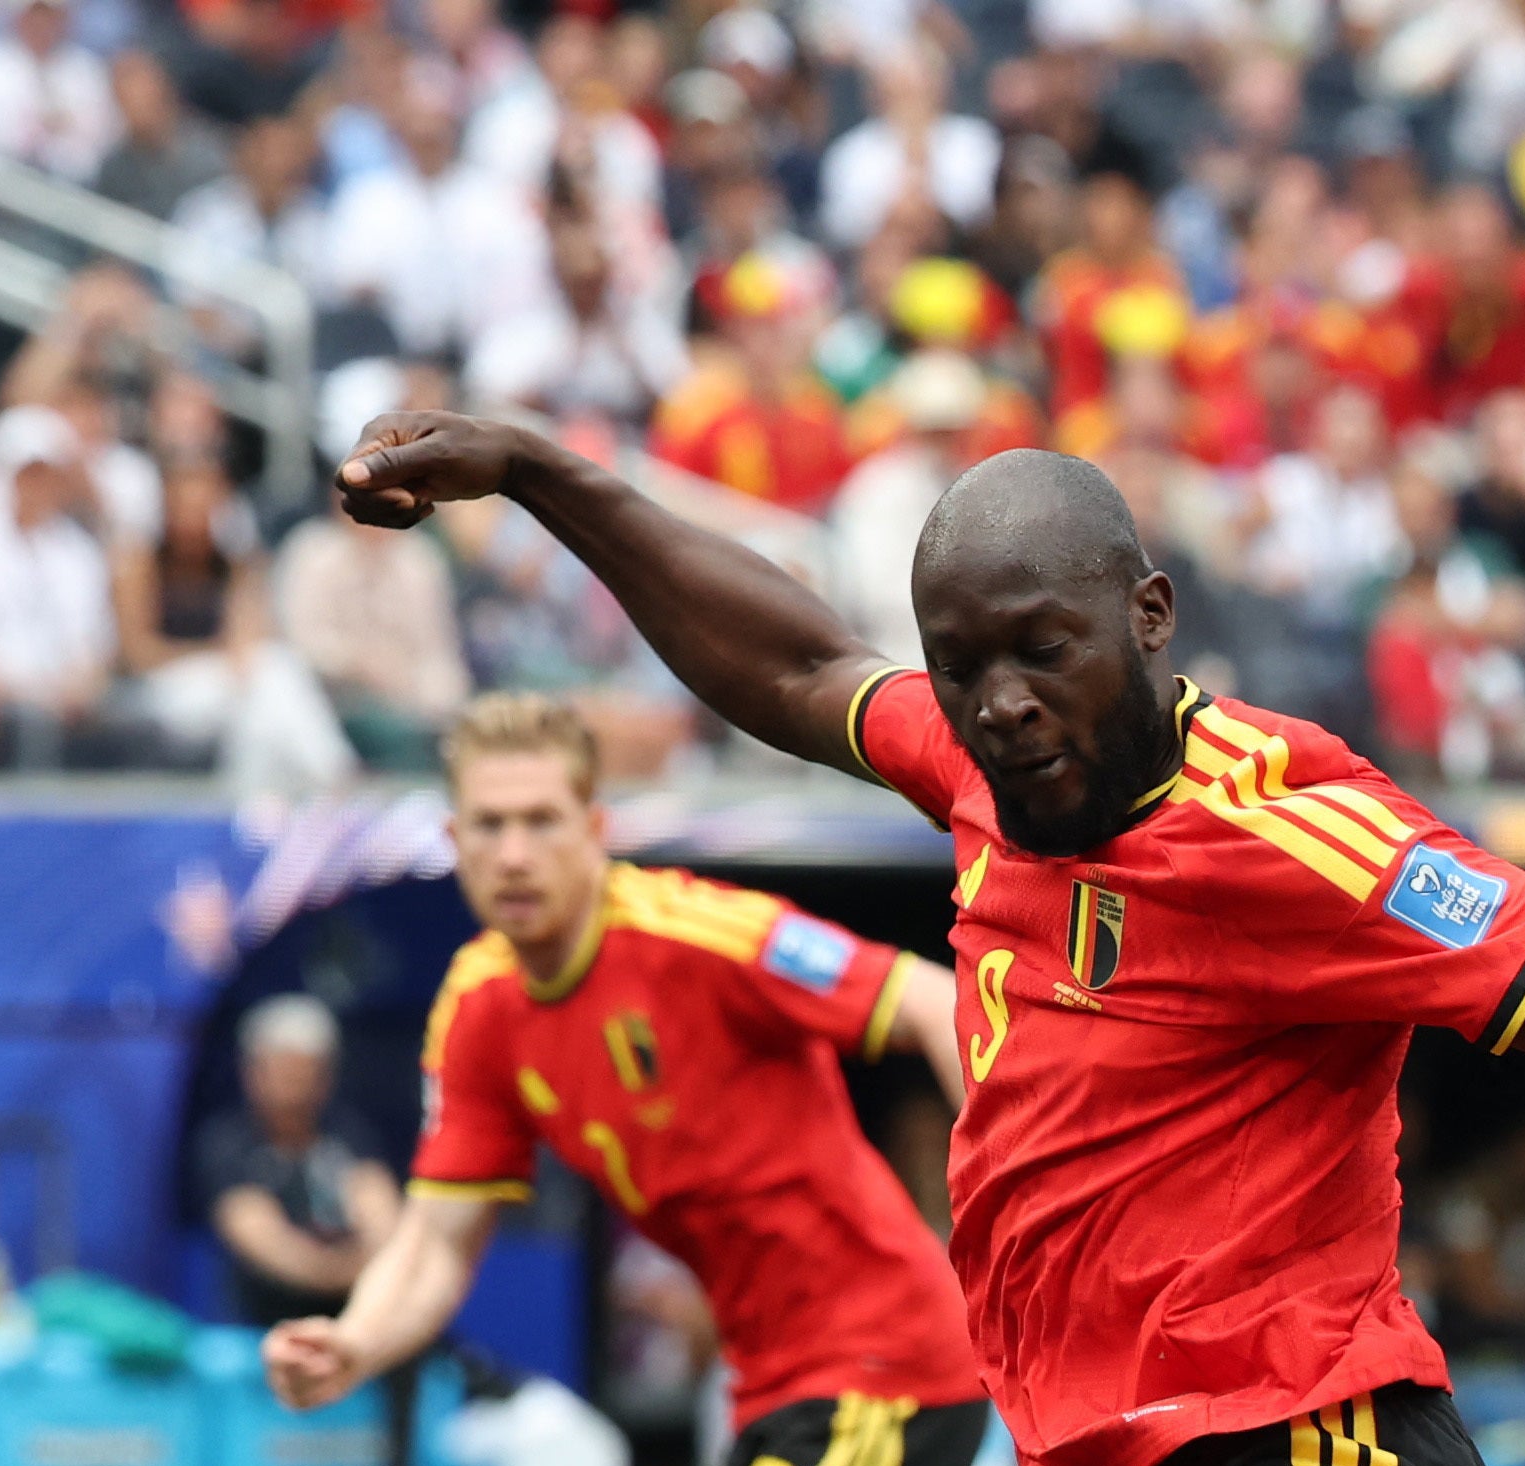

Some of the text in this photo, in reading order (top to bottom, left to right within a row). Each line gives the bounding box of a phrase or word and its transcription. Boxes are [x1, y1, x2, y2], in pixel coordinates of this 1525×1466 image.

[1448, 882, 1481, 926] PEACE
[1469, 900, 1489, 924] FIFA
[970, 948, 1015, 1083] 9
[582, 1120, 650, 1217] 7
